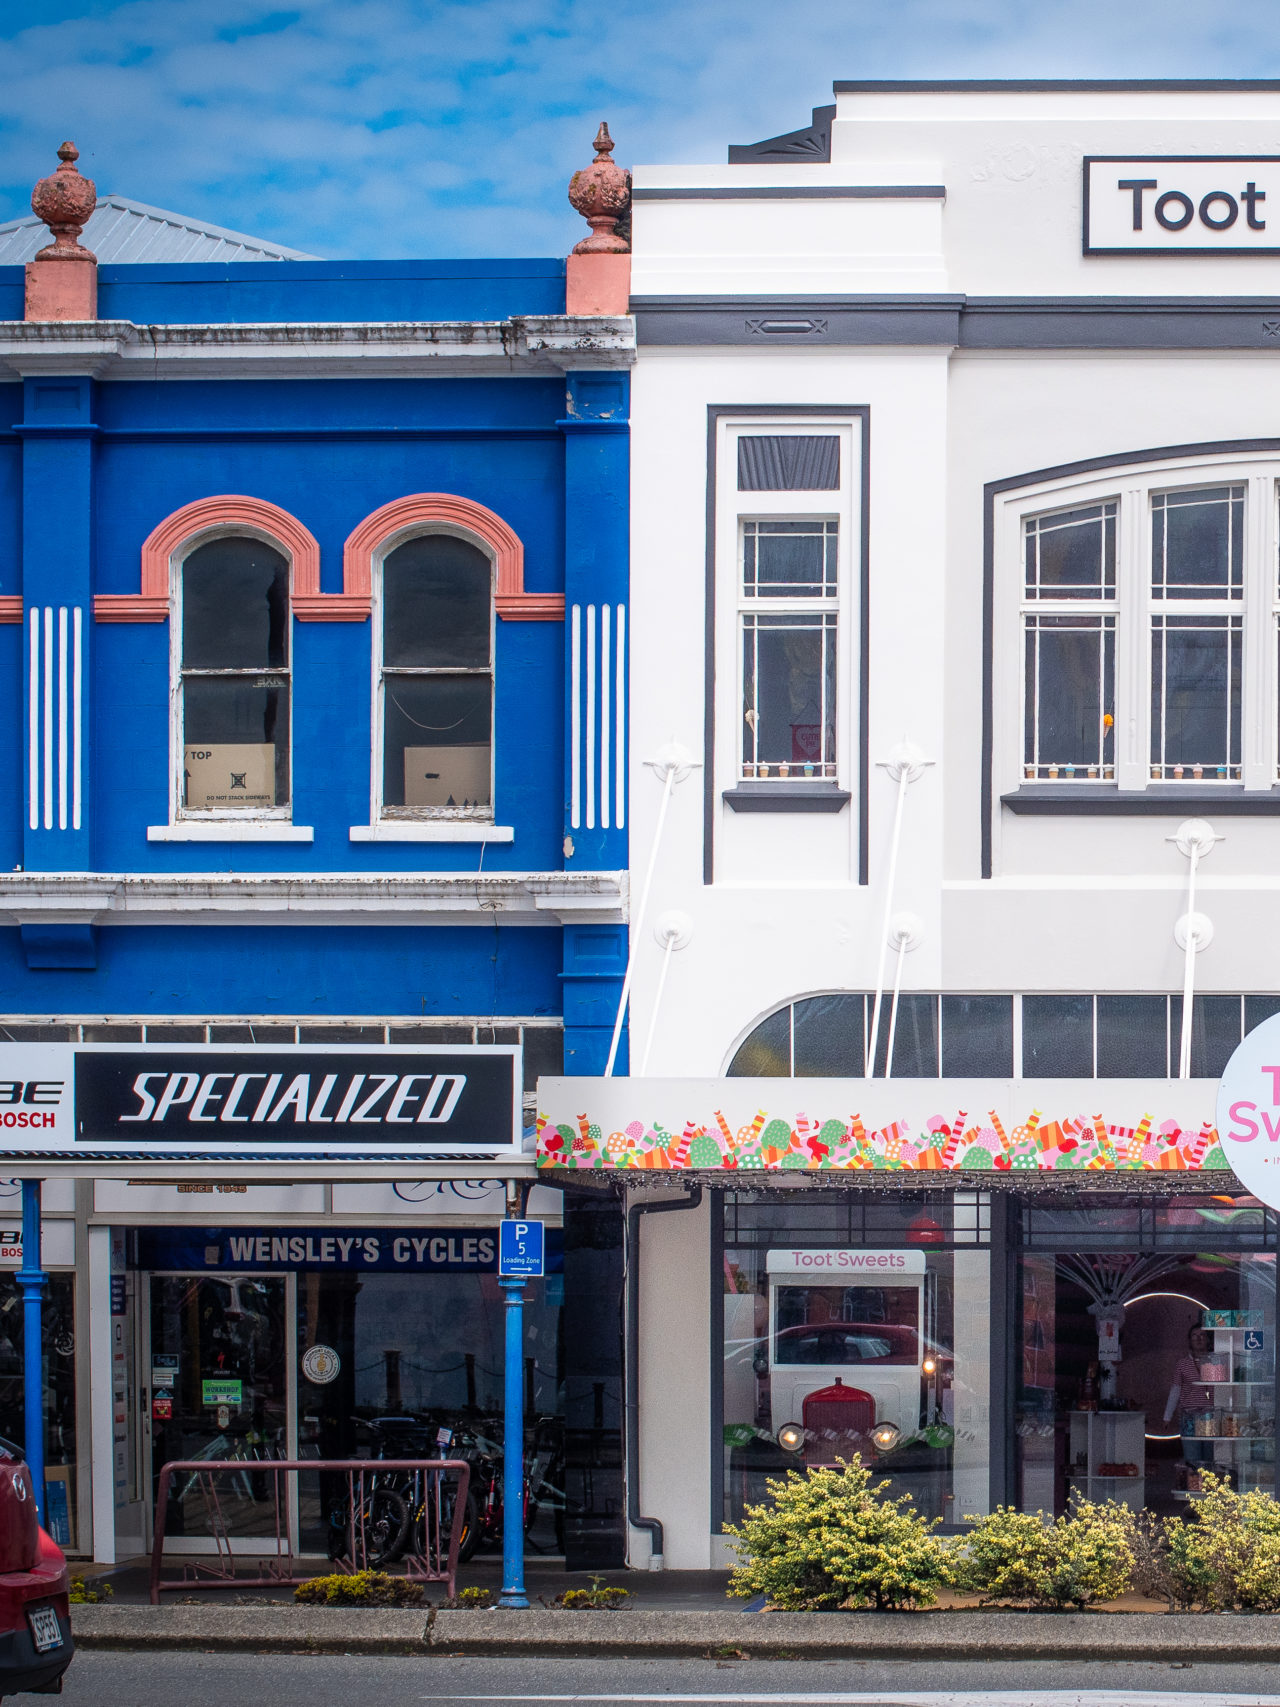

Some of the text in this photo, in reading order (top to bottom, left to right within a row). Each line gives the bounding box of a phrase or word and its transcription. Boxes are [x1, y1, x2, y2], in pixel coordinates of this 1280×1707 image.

[1118, 179, 1266, 231] Toot
[190, 751, 212, 760] TOP
[118, 1072, 468, 1123] SPECIALIZED
[0, 1112, 55, 1128] OSCH
[177, 1184, 214, 1193] SINCE
[516, 1224, 528, 1240] P
[229, 1236, 495, 1263] WENSLEY'S CYCLES
[519, 1242, 526, 1255] 5
[503, 1256, 541, 1265] Loading Zone
[792, 1251, 905, 1267] Toot Sweets
